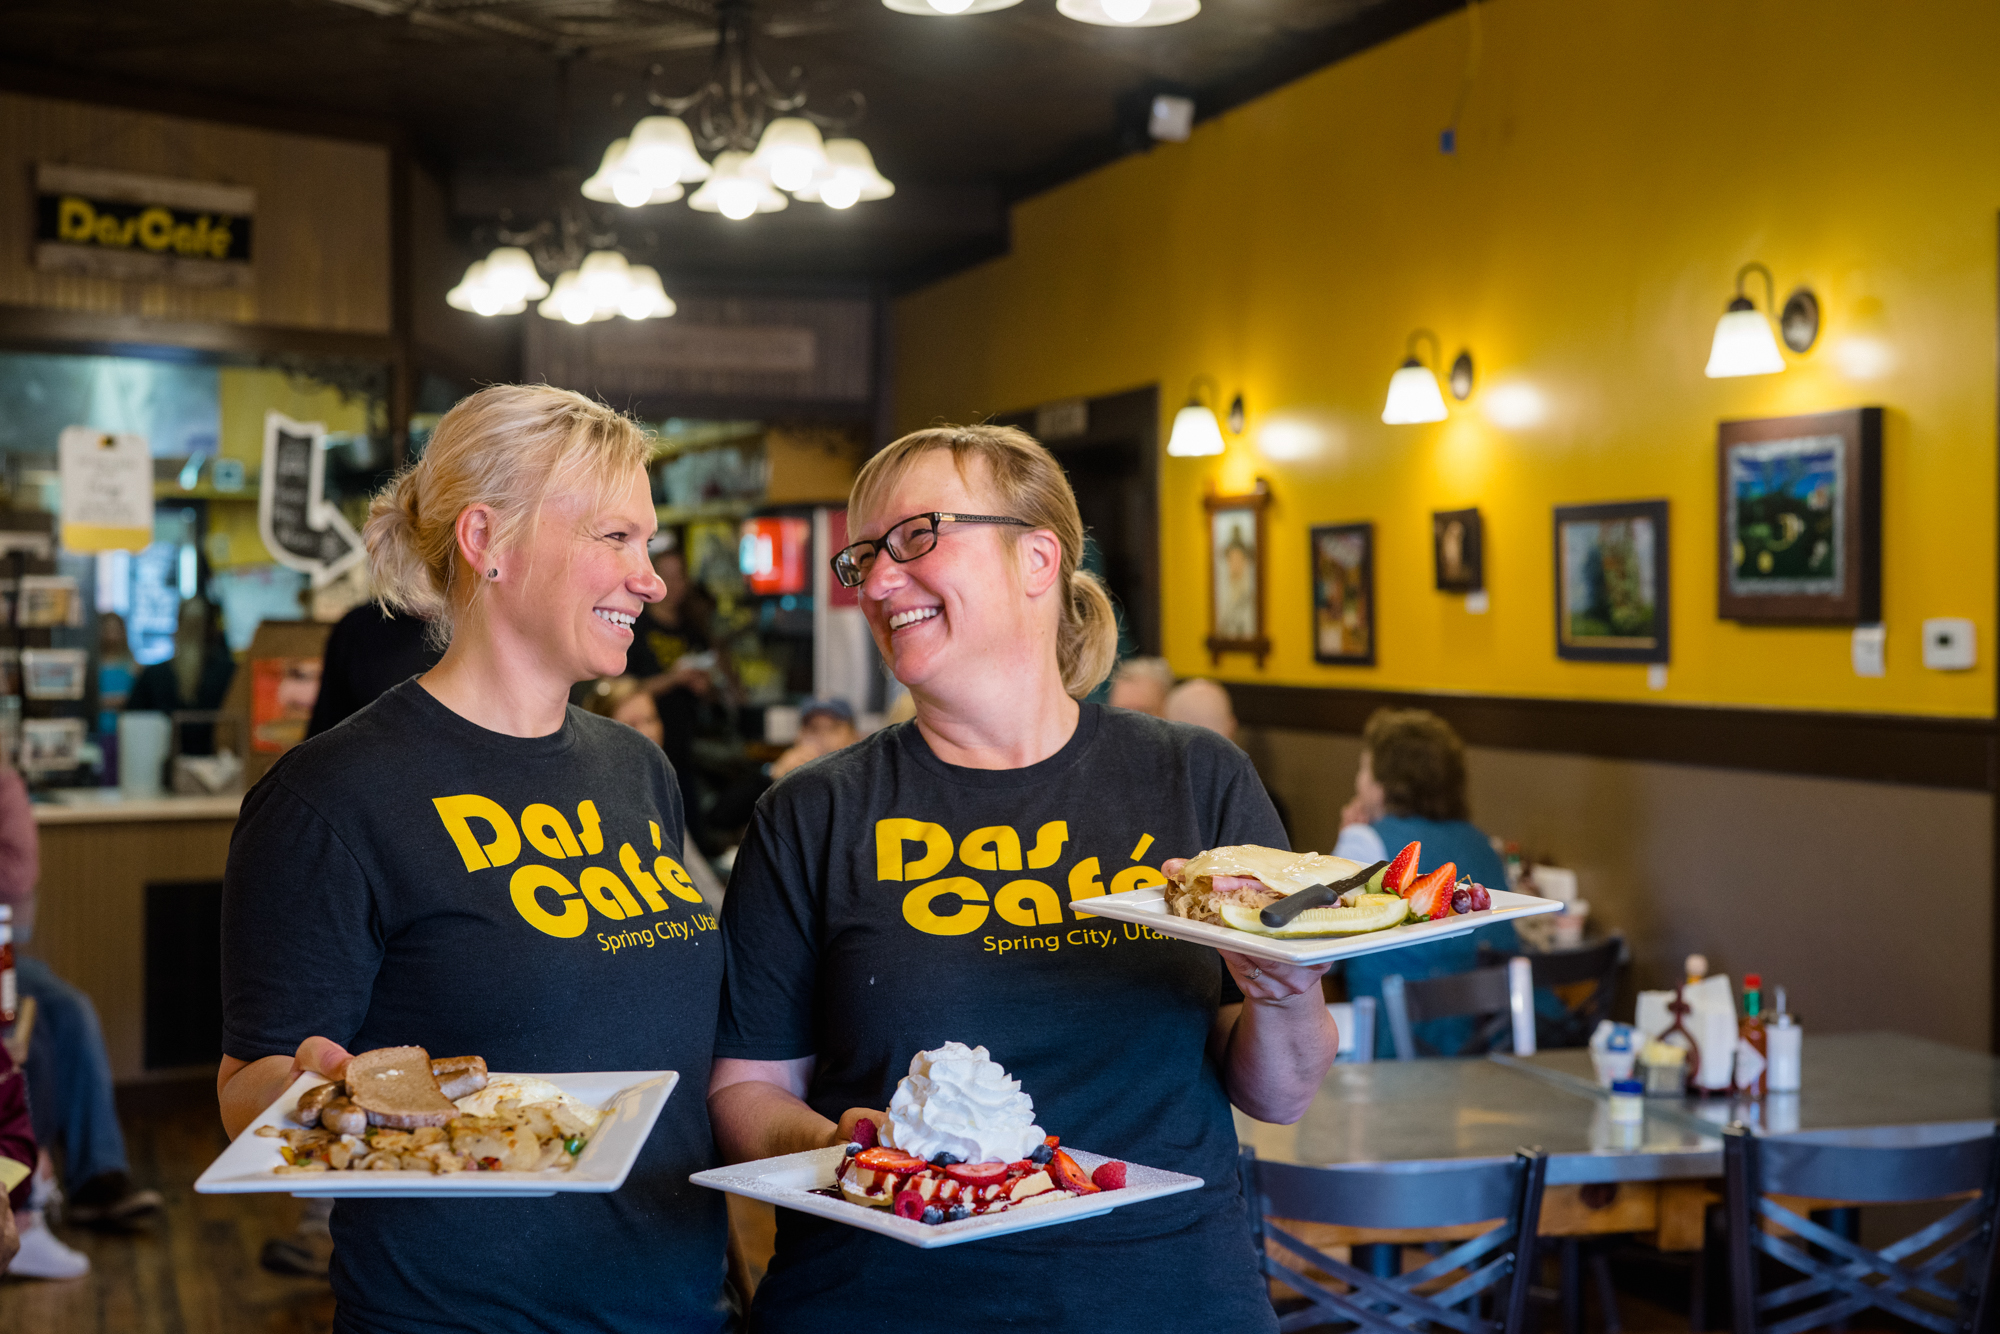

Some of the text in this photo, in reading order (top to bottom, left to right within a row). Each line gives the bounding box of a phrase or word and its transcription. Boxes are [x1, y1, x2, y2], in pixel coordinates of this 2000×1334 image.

[432, 794, 604, 873] Das
[876, 818, 1069, 881] Das
[510, 820, 703, 938] Café
[597, 930, 655, 954] Spring
[655, 921, 694, 941] City,
[983, 923, 1177, 955] Spring City, Uta
